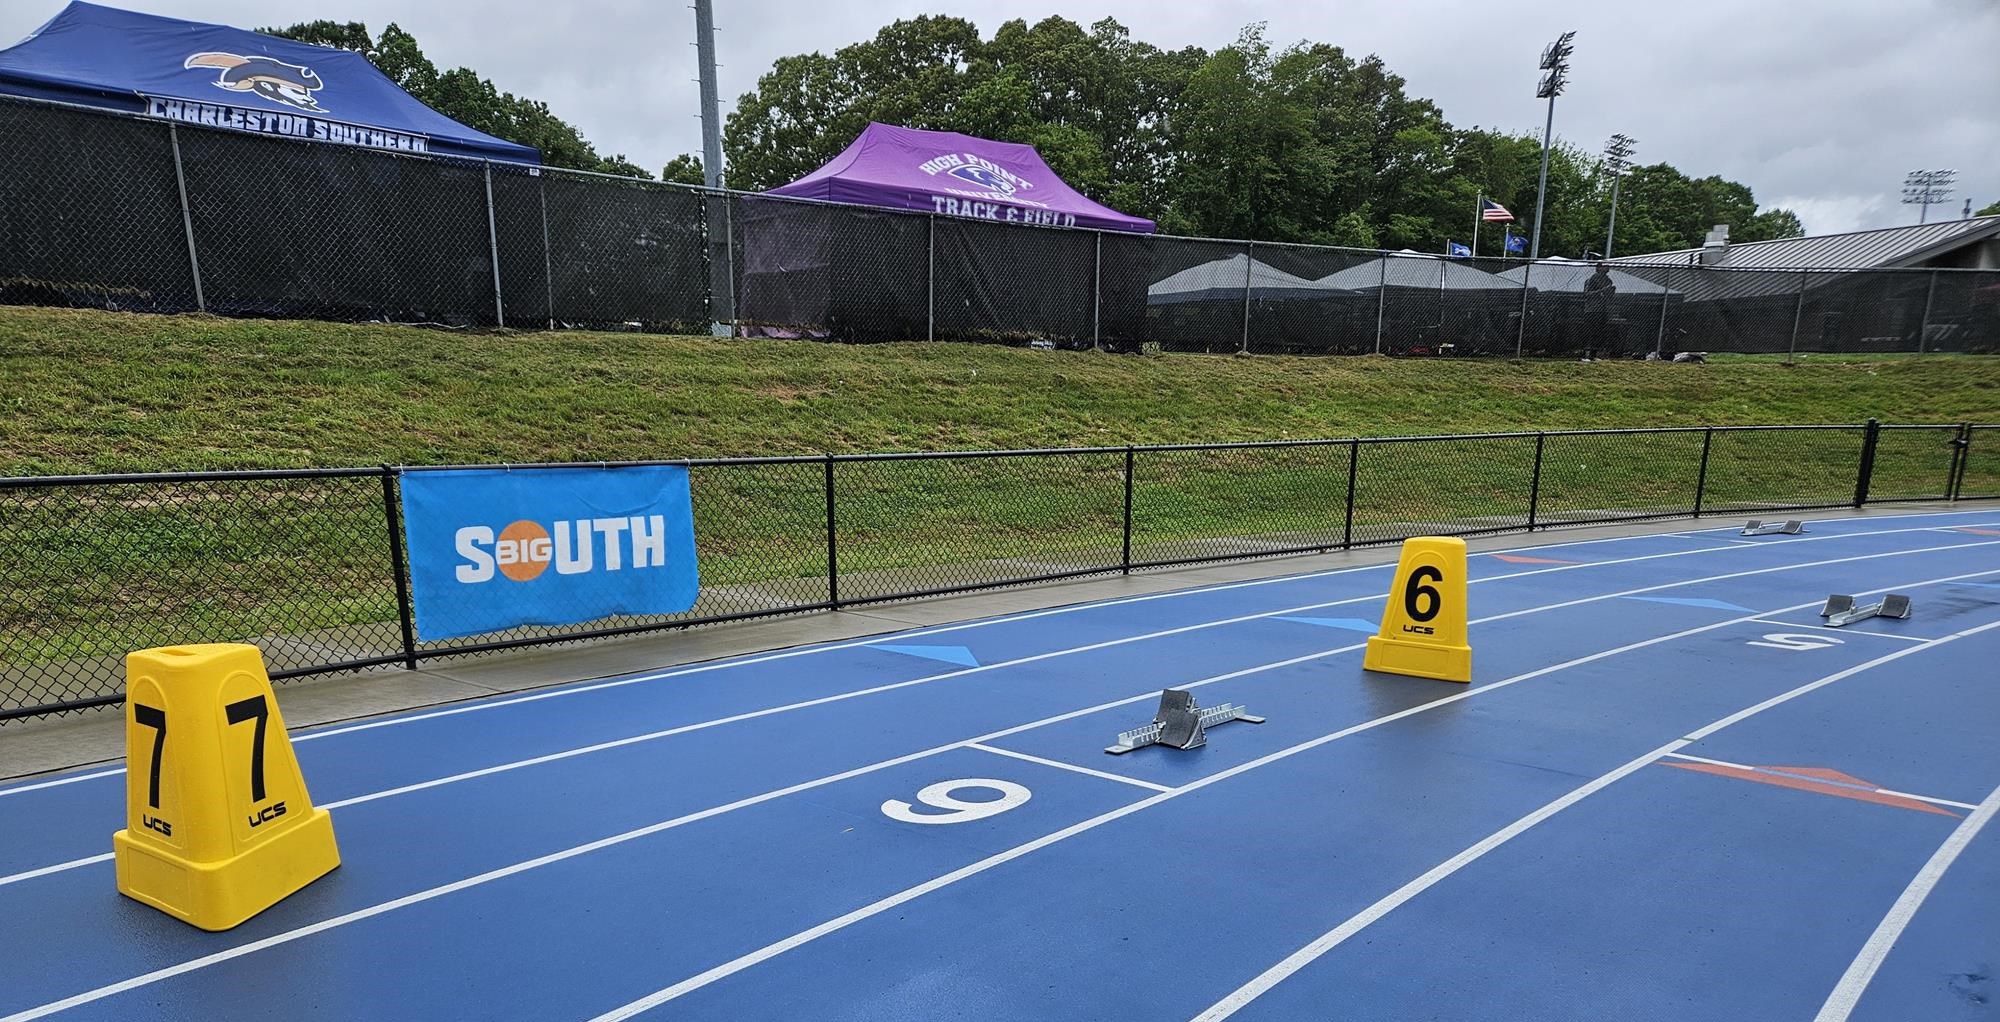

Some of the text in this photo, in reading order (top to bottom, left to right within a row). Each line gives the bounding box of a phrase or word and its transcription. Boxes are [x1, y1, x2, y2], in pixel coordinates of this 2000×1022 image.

[148, 98, 428, 152] CHARLESTON SOUTHERN
[918, 153, 1034, 190] HIGH POINT
[932, 195, 1000, 221] TRACK
[496, 537, 552, 565] BIG
[1405, 565, 1443, 622] 6
[1403, 624, 1434, 635] UCS
[134, 702, 167, 809] 7
[224, 694, 268, 803] 7
[143, 813, 171, 837] UCS
[248, 801, 287, 827] UCS
